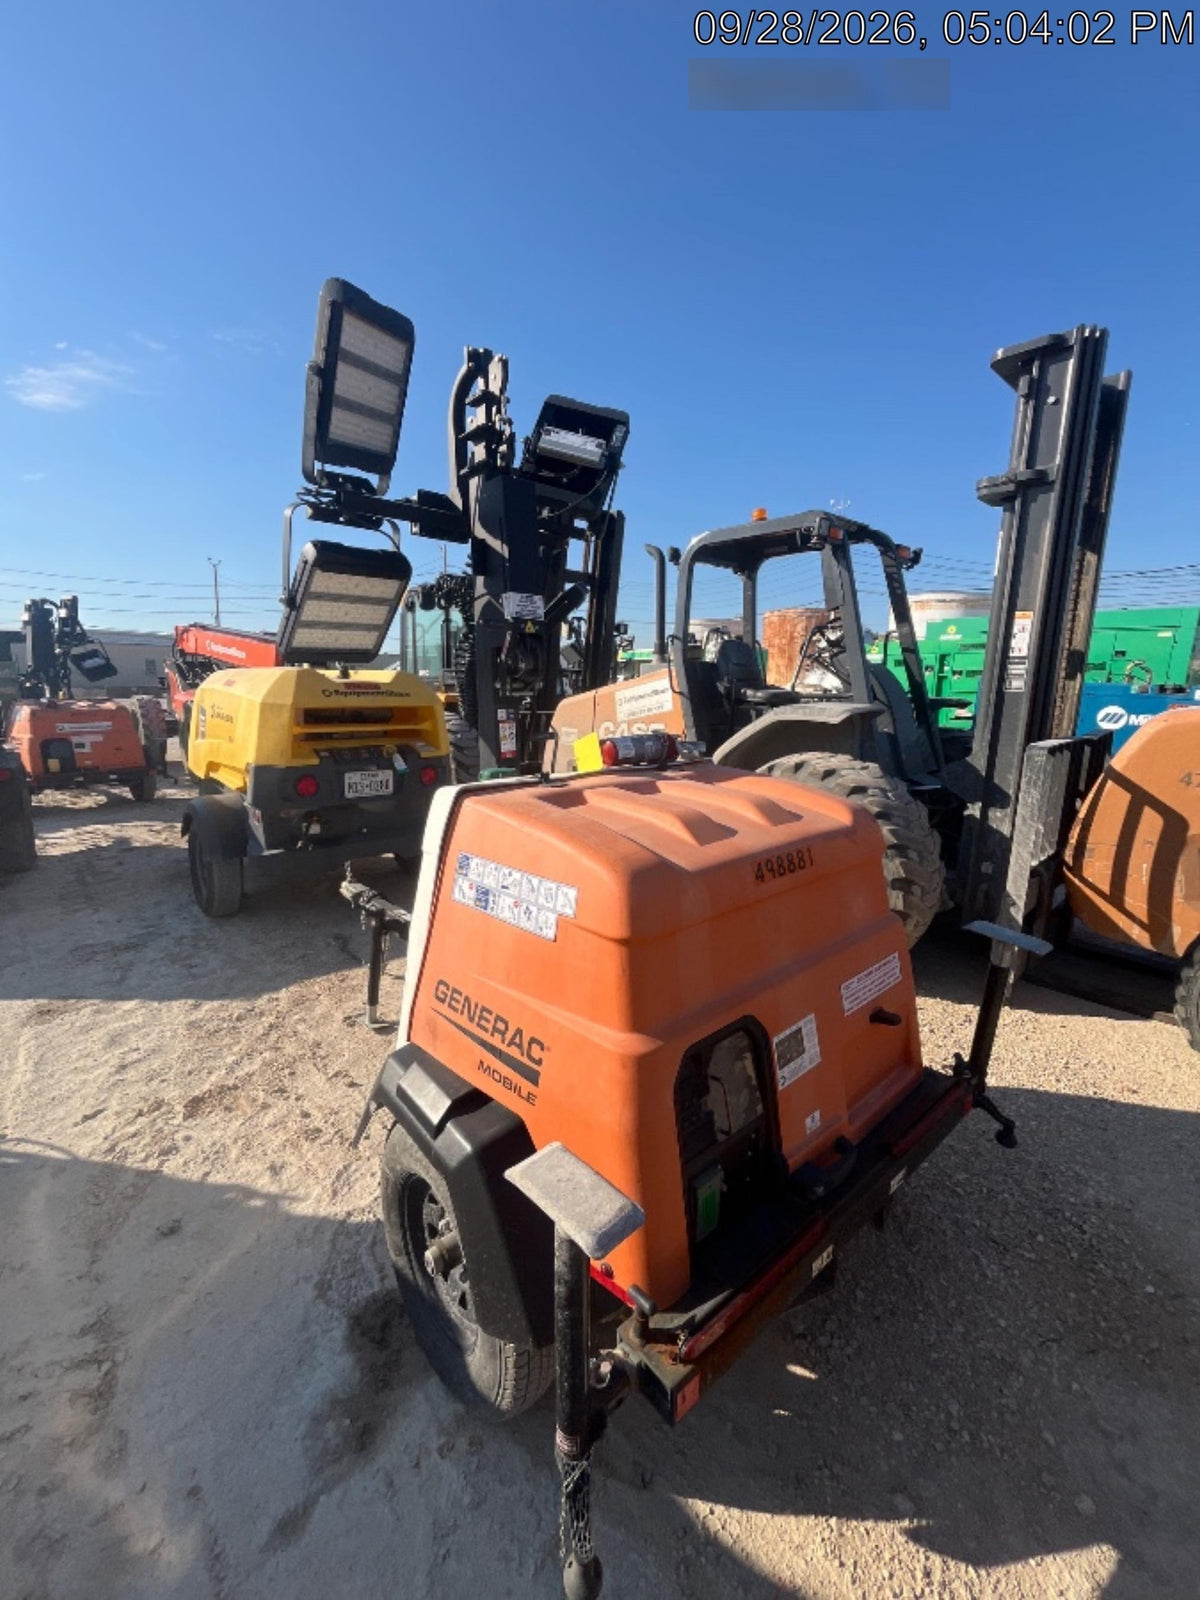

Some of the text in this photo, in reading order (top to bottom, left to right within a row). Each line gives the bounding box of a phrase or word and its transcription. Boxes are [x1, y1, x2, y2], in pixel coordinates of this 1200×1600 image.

[755, 847, 814, 882] 498881
[433, 978, 545, 1068] GENERAC
[477, 1058, 538, 1107] MOBILE
